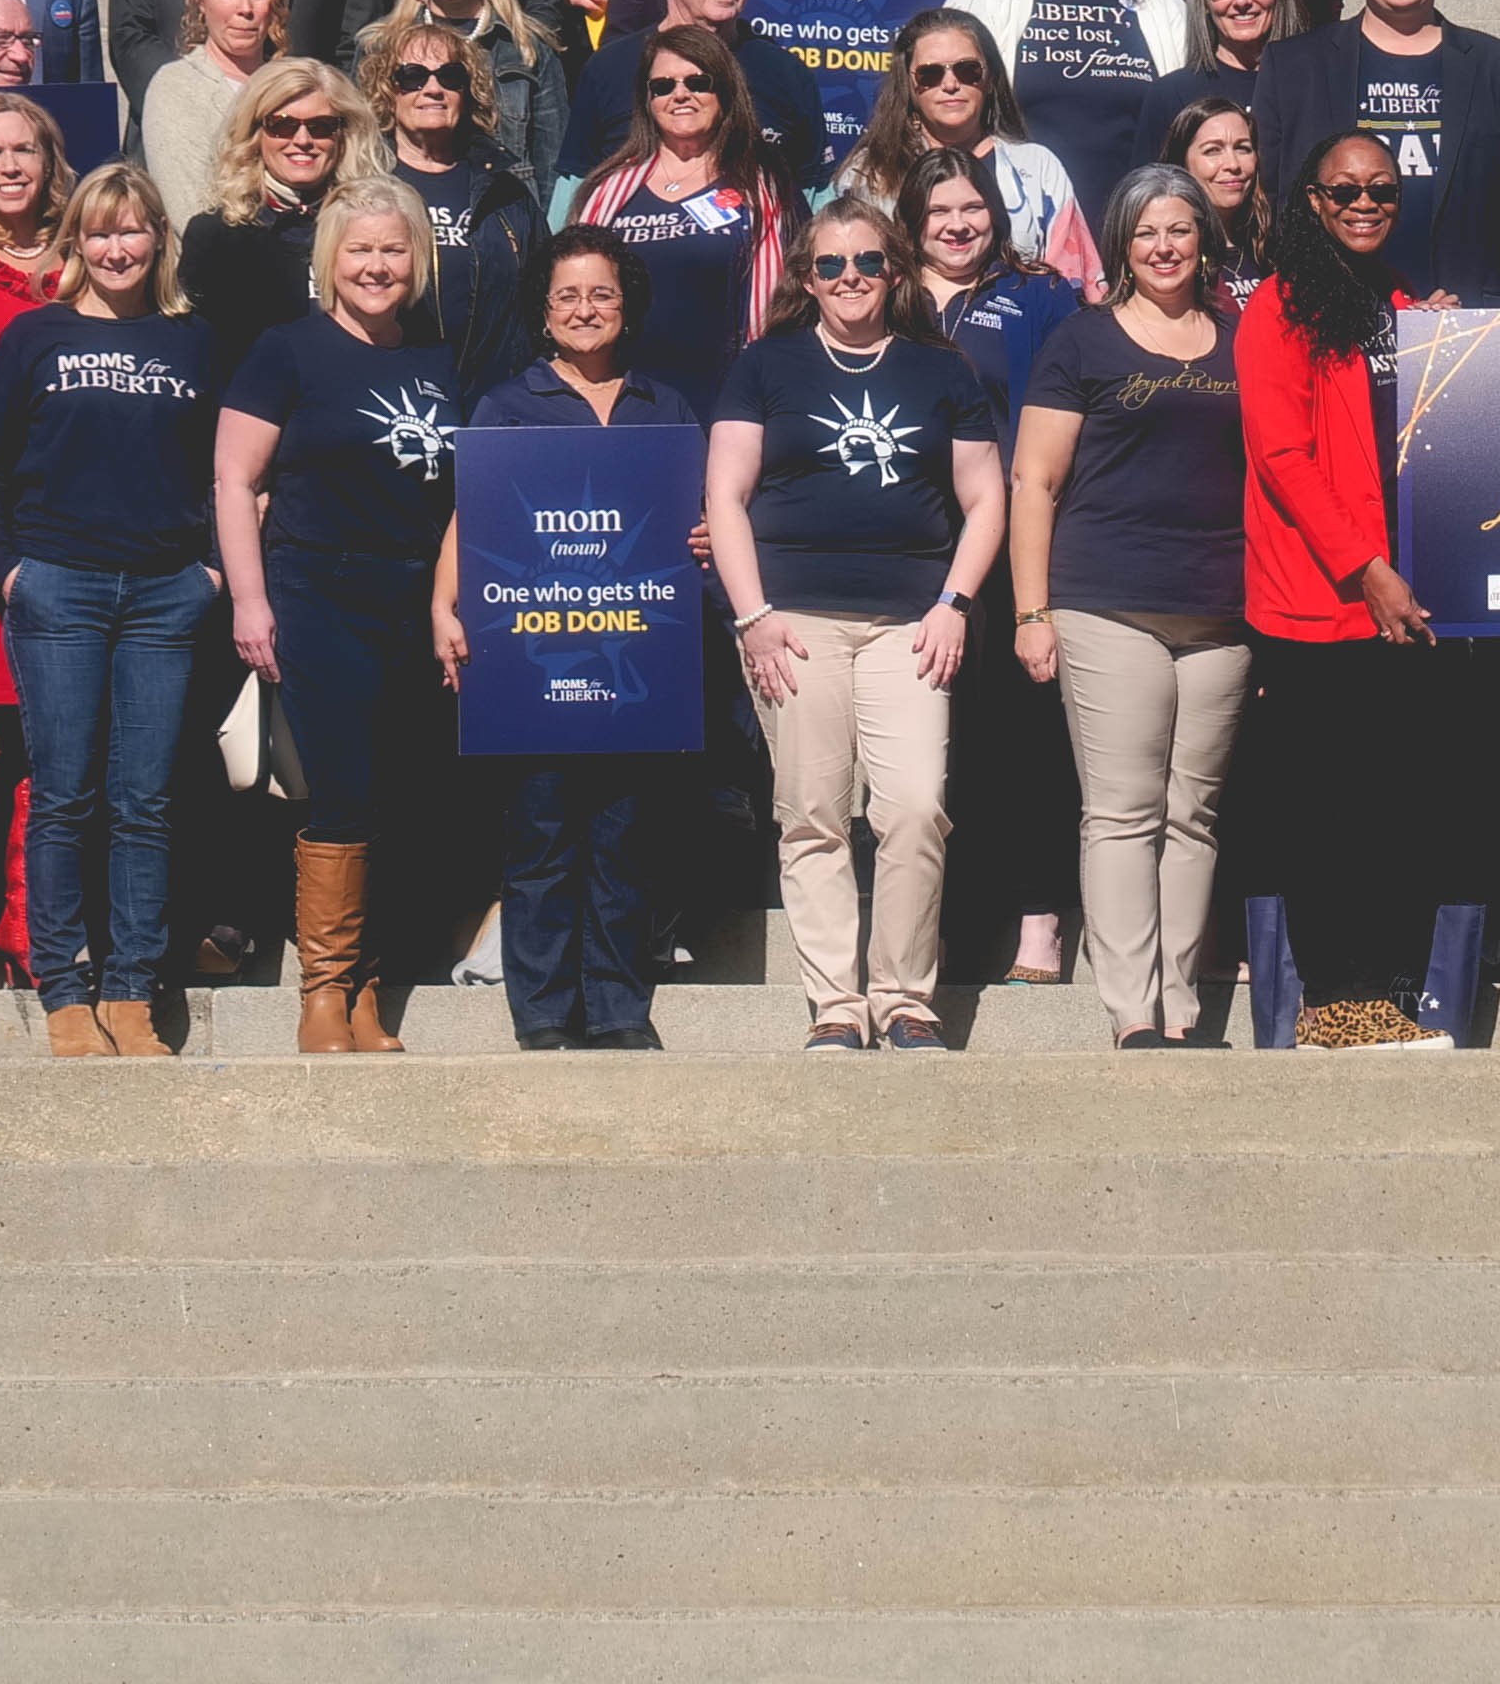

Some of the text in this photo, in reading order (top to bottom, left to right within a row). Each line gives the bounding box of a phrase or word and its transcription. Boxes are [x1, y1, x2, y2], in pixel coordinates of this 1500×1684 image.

[751, 17, 793, 38] One
[797, 20, 841, 40] who
[846, 26, 889, 46] gets
[1022, 25, 1120, 47] once lost,
[1021, 45, 1038, 63] is
[1045, 46, 1083, 63] lost
[1091, 68, 1153, 82] JOHN ADAMS
[1368, 82, 1419, 97] MOMS
[1369, 98, 1440, 113] LIBERT
[612, 212, 679, 228] MOMS
[622, 222, 716, 243] IBERT
[58, 352, 171, 377] MOMS for
[60, 370, 187, 398] LIBERTY
[1182, 369, 1241, 395] Warri
[534, 508, 623, 533] mom
[550, 539, 607, 559] (noun)
[483, 580, 675, 606] One who gets the
[511, 610, 649, 634] JOB DONE.
[551, 678, 603, 691] MOMS for
[551, 689, 611, 702] LIBERTY
